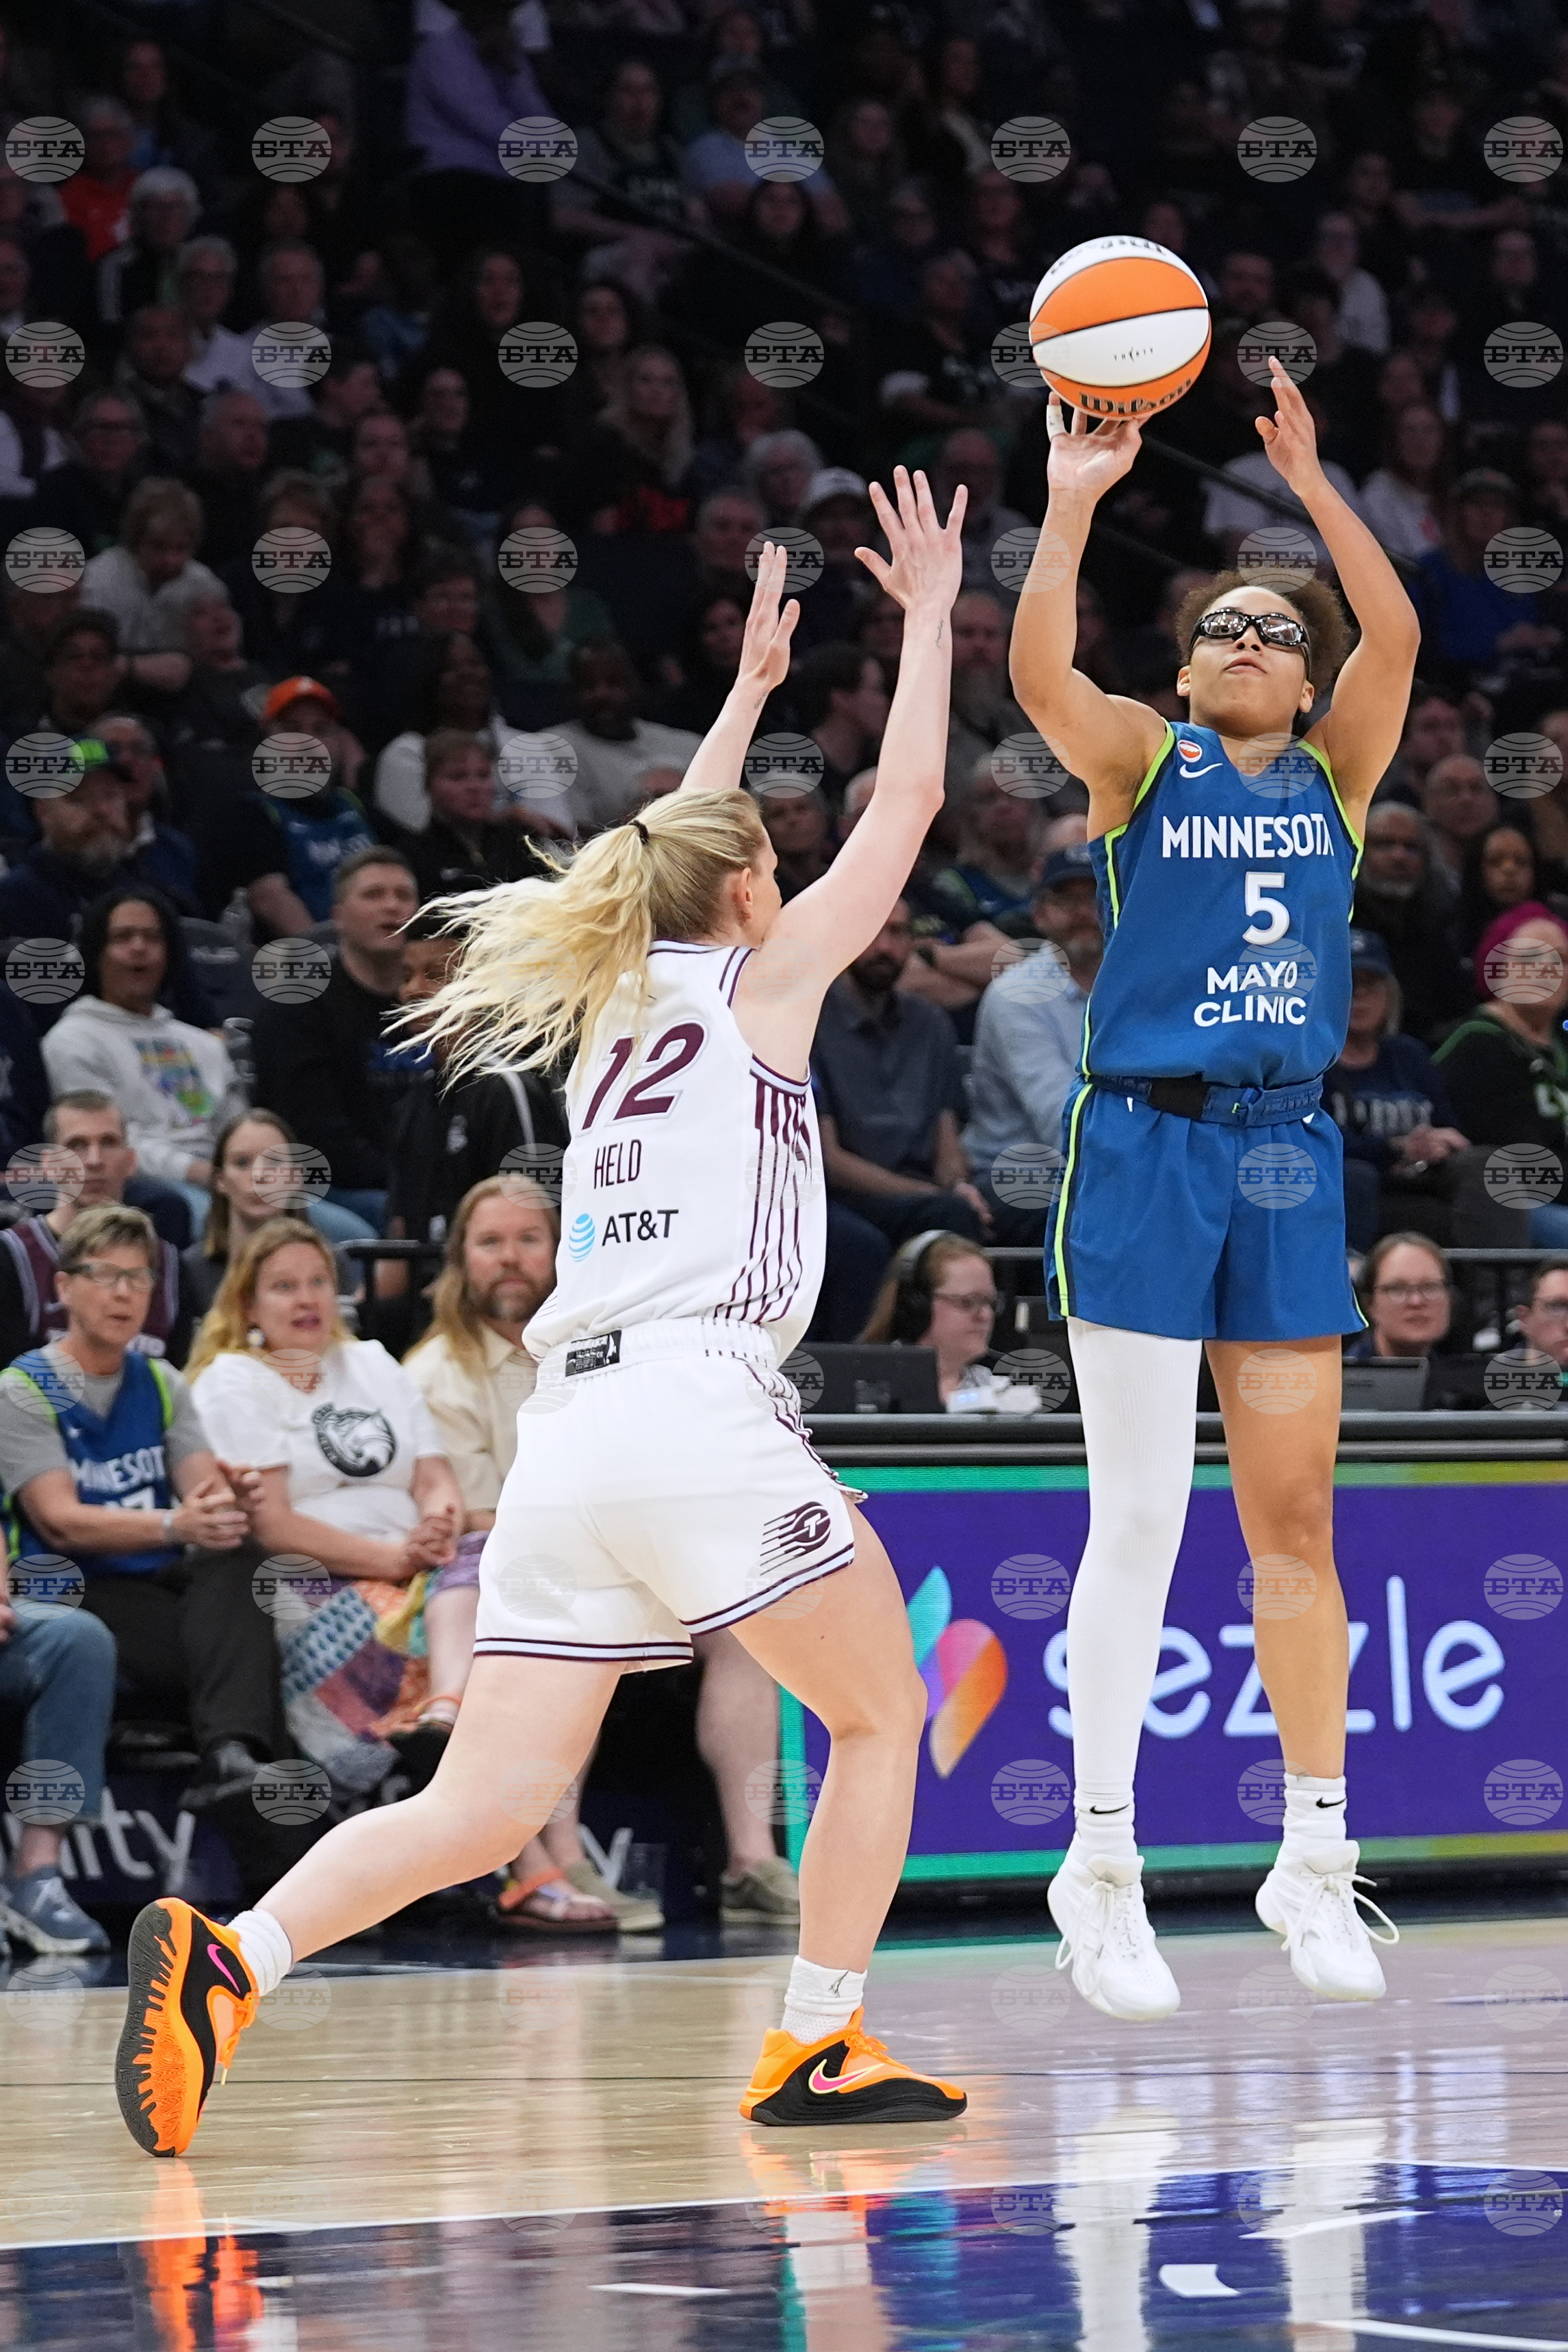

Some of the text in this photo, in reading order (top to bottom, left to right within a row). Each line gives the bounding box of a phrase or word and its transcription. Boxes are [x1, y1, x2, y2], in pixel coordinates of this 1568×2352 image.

[1242, 871, 1290, 945] 5
[1207, 960, 1298, 995] MAYO
[1194, 995, 1307, 1027] CLINIC
[579, 1021, 707, 1134] 12
[594, 1138, 642, 1190] HELD
[602, 1209, 679, 1247] AT&T
